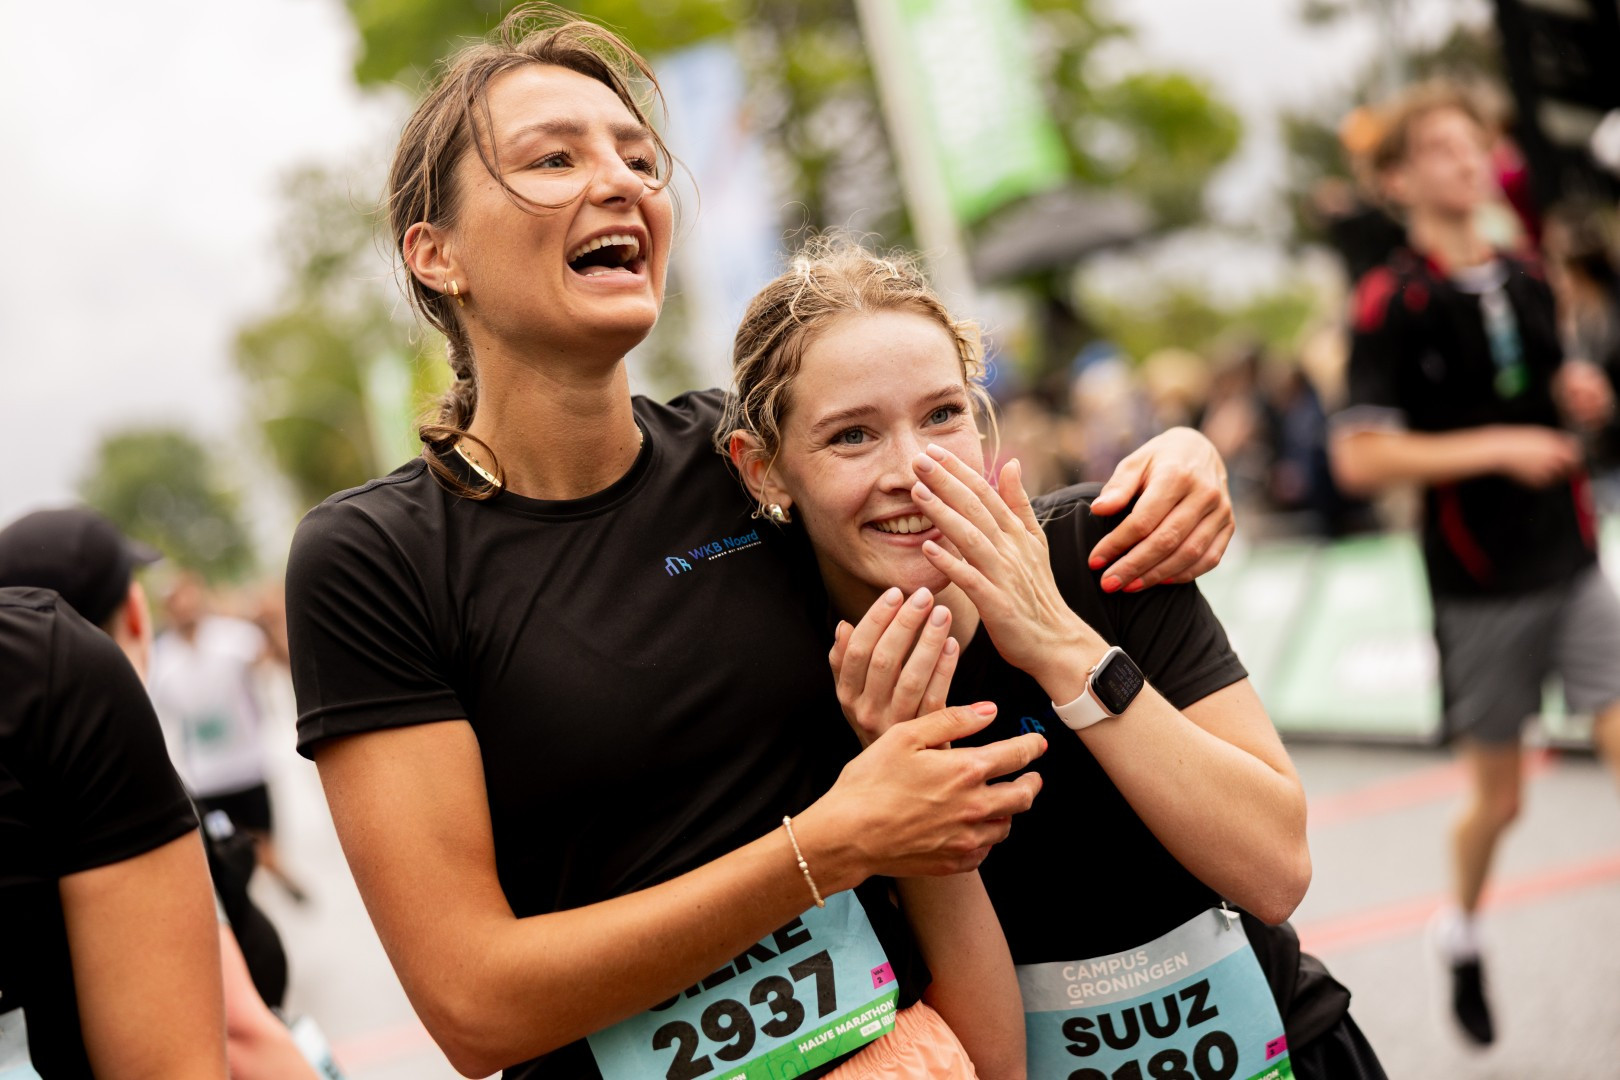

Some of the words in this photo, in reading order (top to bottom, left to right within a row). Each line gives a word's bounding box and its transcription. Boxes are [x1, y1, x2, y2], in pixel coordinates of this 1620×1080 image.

[688, 542, 722, 560] WKB
[722, 529, 759, 549] Noord
[1062, 950, 1149, 982] CAMPUS
[1066, 951, 1190, 1000] GRONINGEN
[652, 949, 837, 1080] 2937
[798, 1029, 835, 1054] HALVE
[835, 998, 895, 1036] MARATHON
[1061, 978, 1220, 1058] SUUZ
